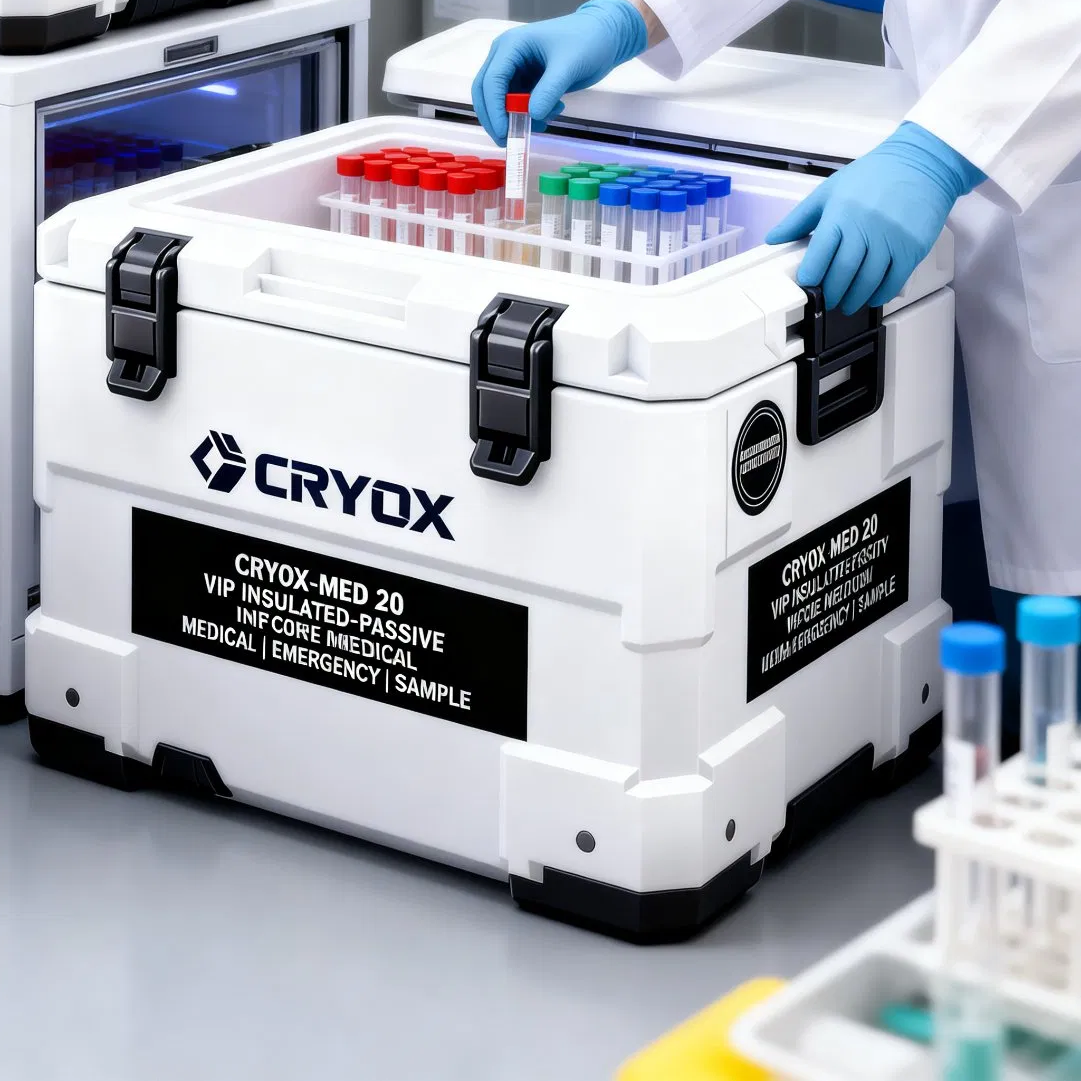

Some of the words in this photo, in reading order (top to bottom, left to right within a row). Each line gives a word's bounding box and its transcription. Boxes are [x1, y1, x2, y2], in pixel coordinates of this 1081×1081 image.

[255, 453, 456, 542] CRYOX
[862, 513, 878, 541] 20
[203, 572, 236, 598] VIP
[241, 582, 446, 653] INSULATED-PASSIVE
[234, 553, 368, 605] CRYOX-MED
[374, 589, 404, 616] 20
[182, 614, 258, 653] MEDICAL
[271, 639, 382, 686] EMERGENCY
[394, 673, 473, 711] SAMPLE
